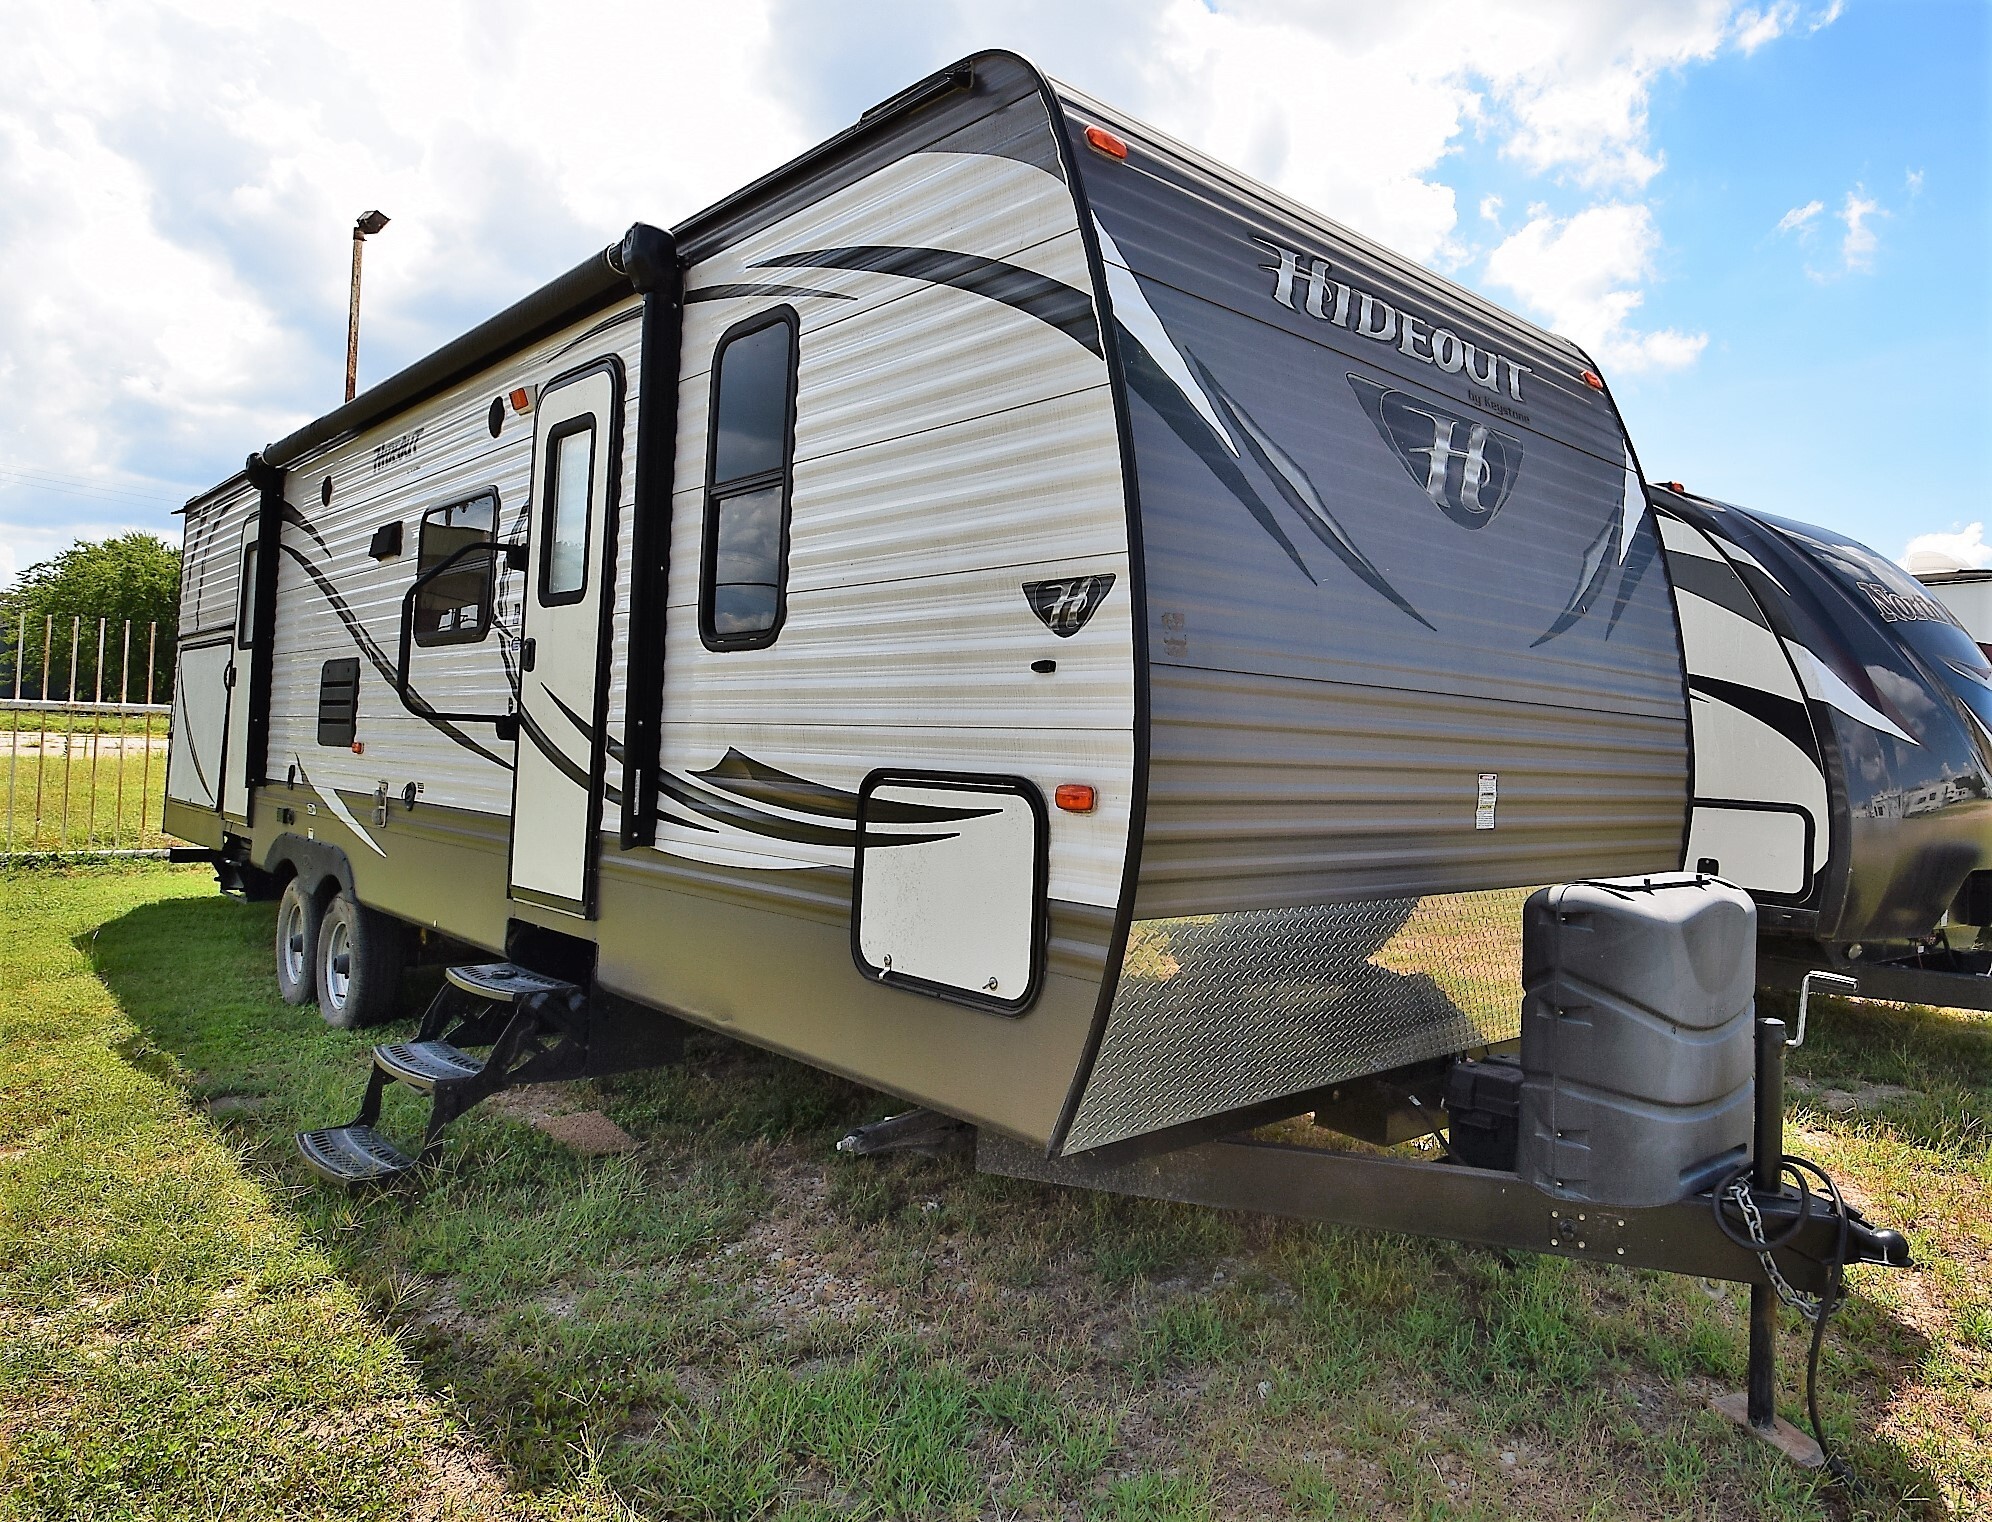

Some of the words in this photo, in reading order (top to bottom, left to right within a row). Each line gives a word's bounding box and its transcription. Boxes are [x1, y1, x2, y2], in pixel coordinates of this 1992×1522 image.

[1250, 234, 1533, 402] HIDEOUT
[1402, 405, 1491, 514] H
[1468, 389, 1481, 406] by
[1485, 396, 1530, 423] Keystone
